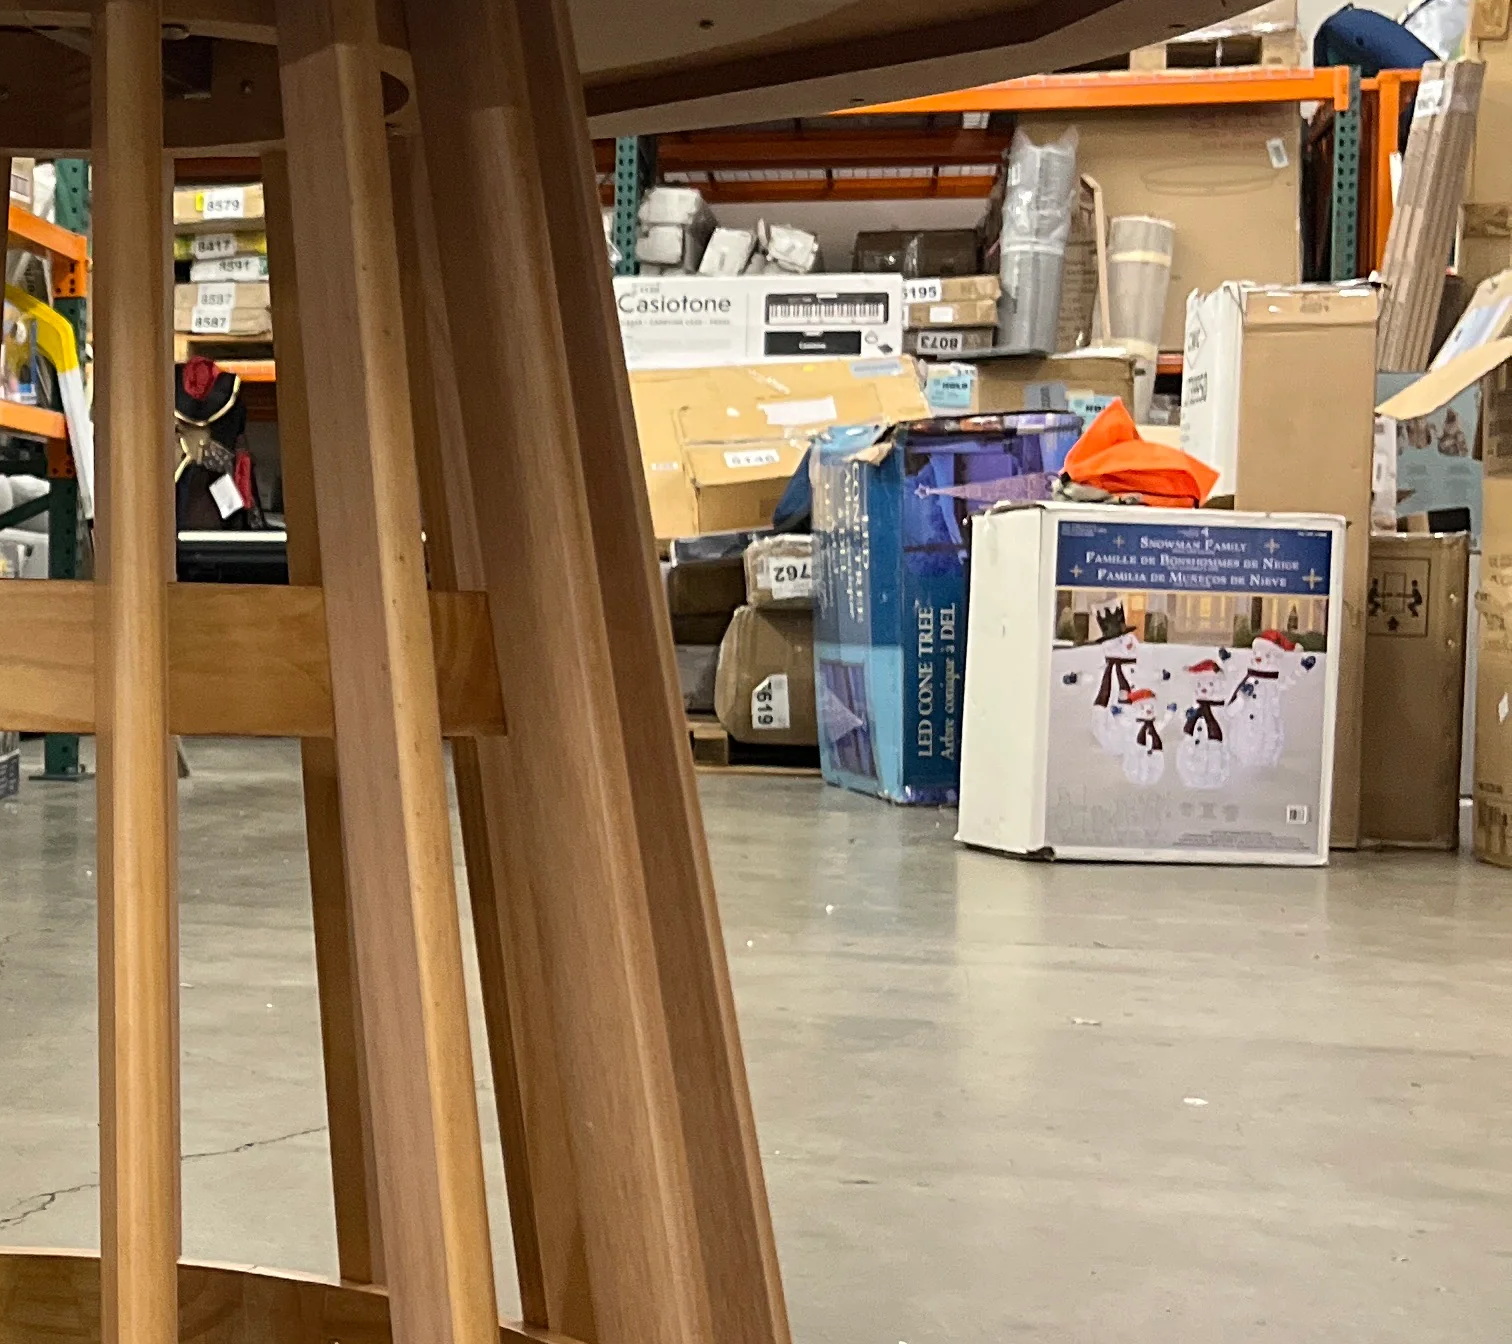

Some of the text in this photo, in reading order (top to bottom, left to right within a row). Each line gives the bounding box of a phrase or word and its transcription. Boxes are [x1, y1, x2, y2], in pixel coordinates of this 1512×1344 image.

[207, 199, 240, 212] 8579
[617, 292, 732, 315] Casiotone
[921, 336, 959, 352] 8073
[773, 563, 811, 584] 762
[940, 603, 956, 641] DEL
[918, 606, 934, 757] LED CONE TREE
